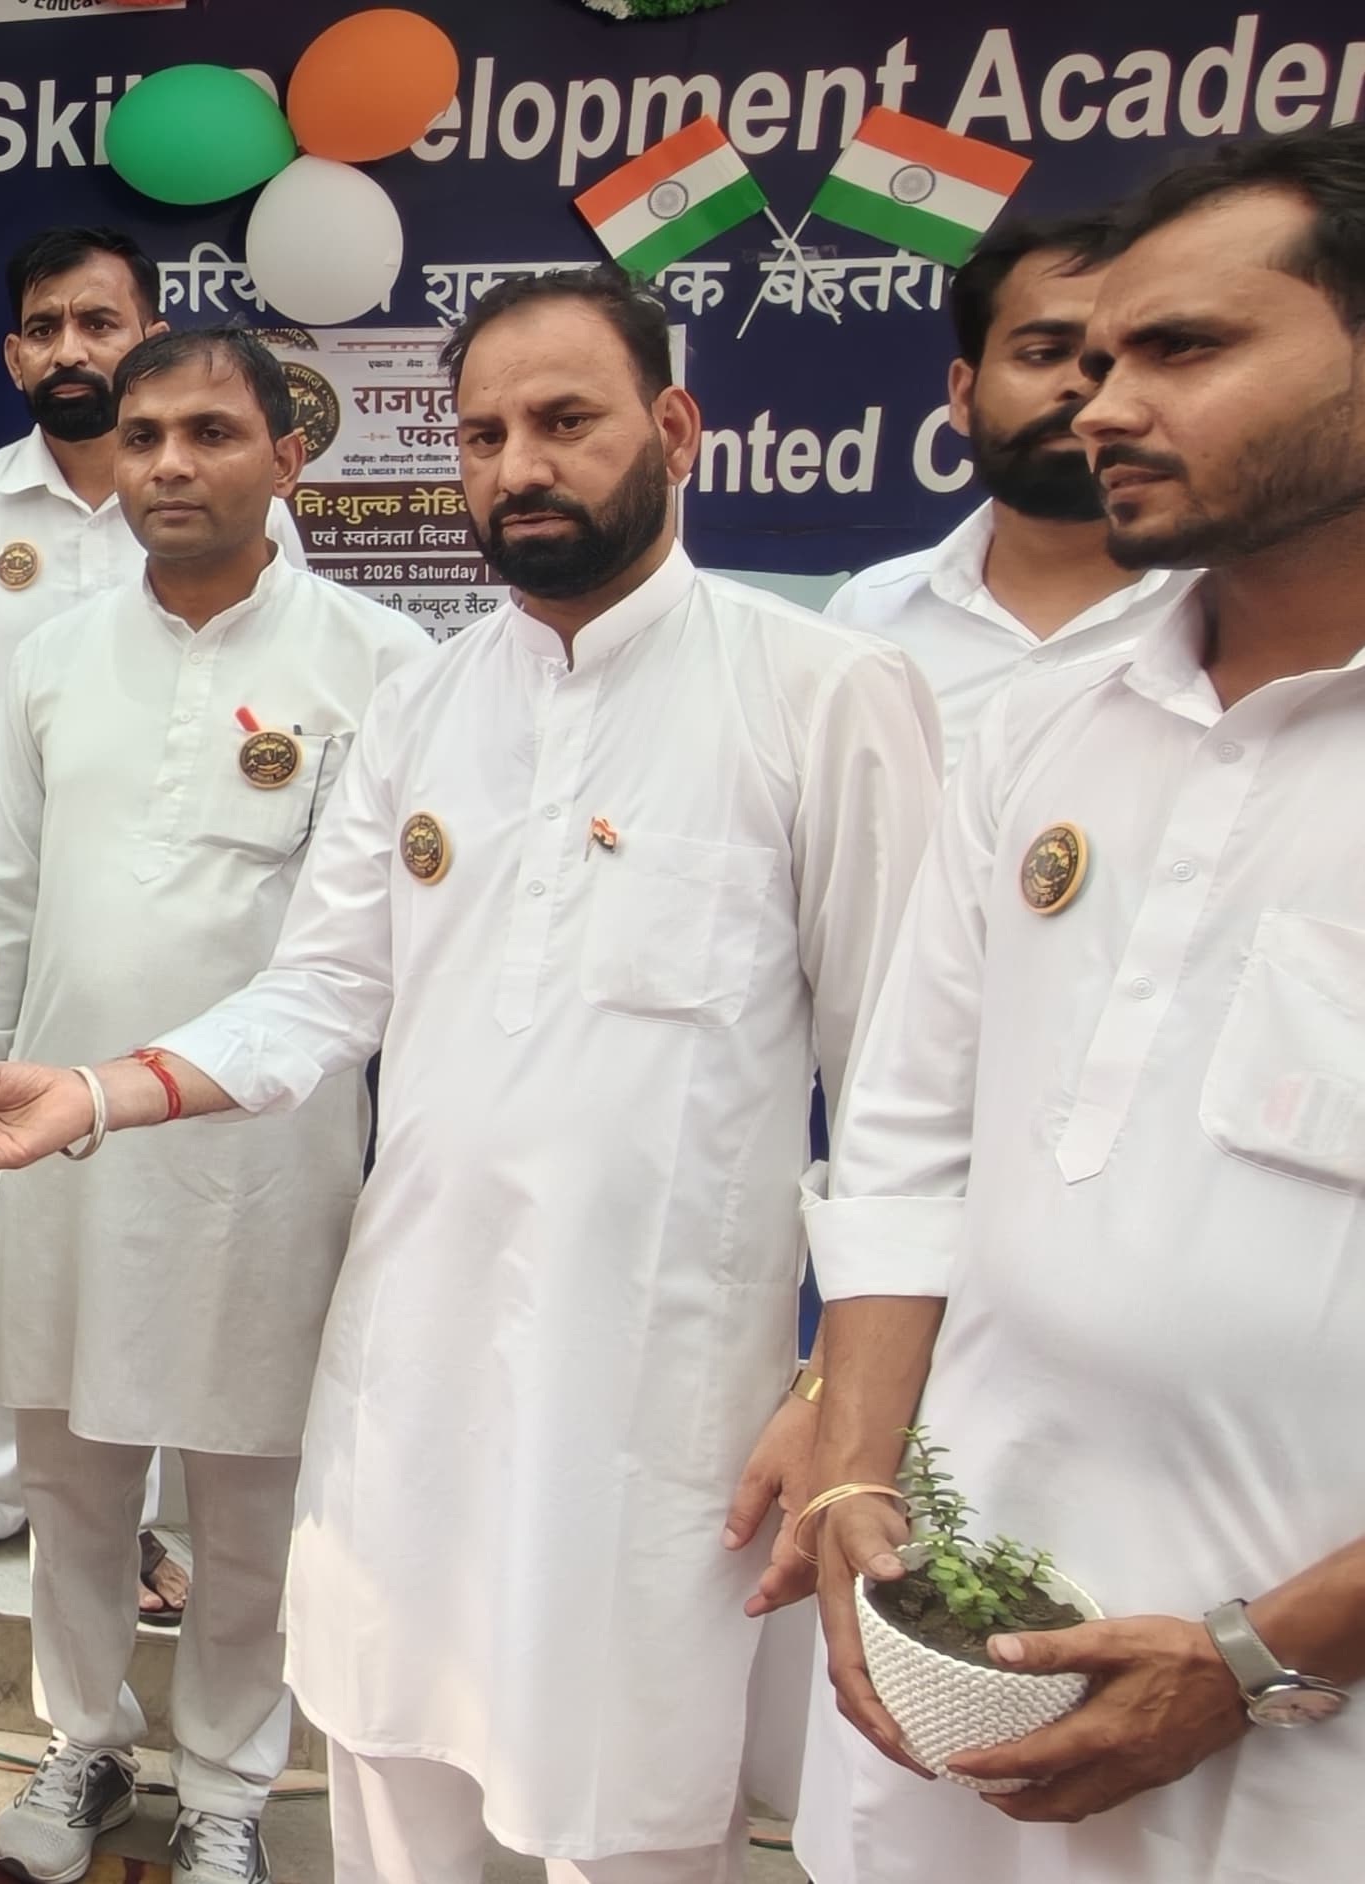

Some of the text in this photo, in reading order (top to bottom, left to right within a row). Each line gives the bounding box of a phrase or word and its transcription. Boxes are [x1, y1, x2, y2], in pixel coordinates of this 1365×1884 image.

[352, 386, 458, 424] राजपूत
[698, 406, 883, 494] nted
[311, 524, 468, 546] एवं स्वतंत्रता दिवस
[363, 564, 404, 580] 2026
[408, 563, 478, 583] Saturday
